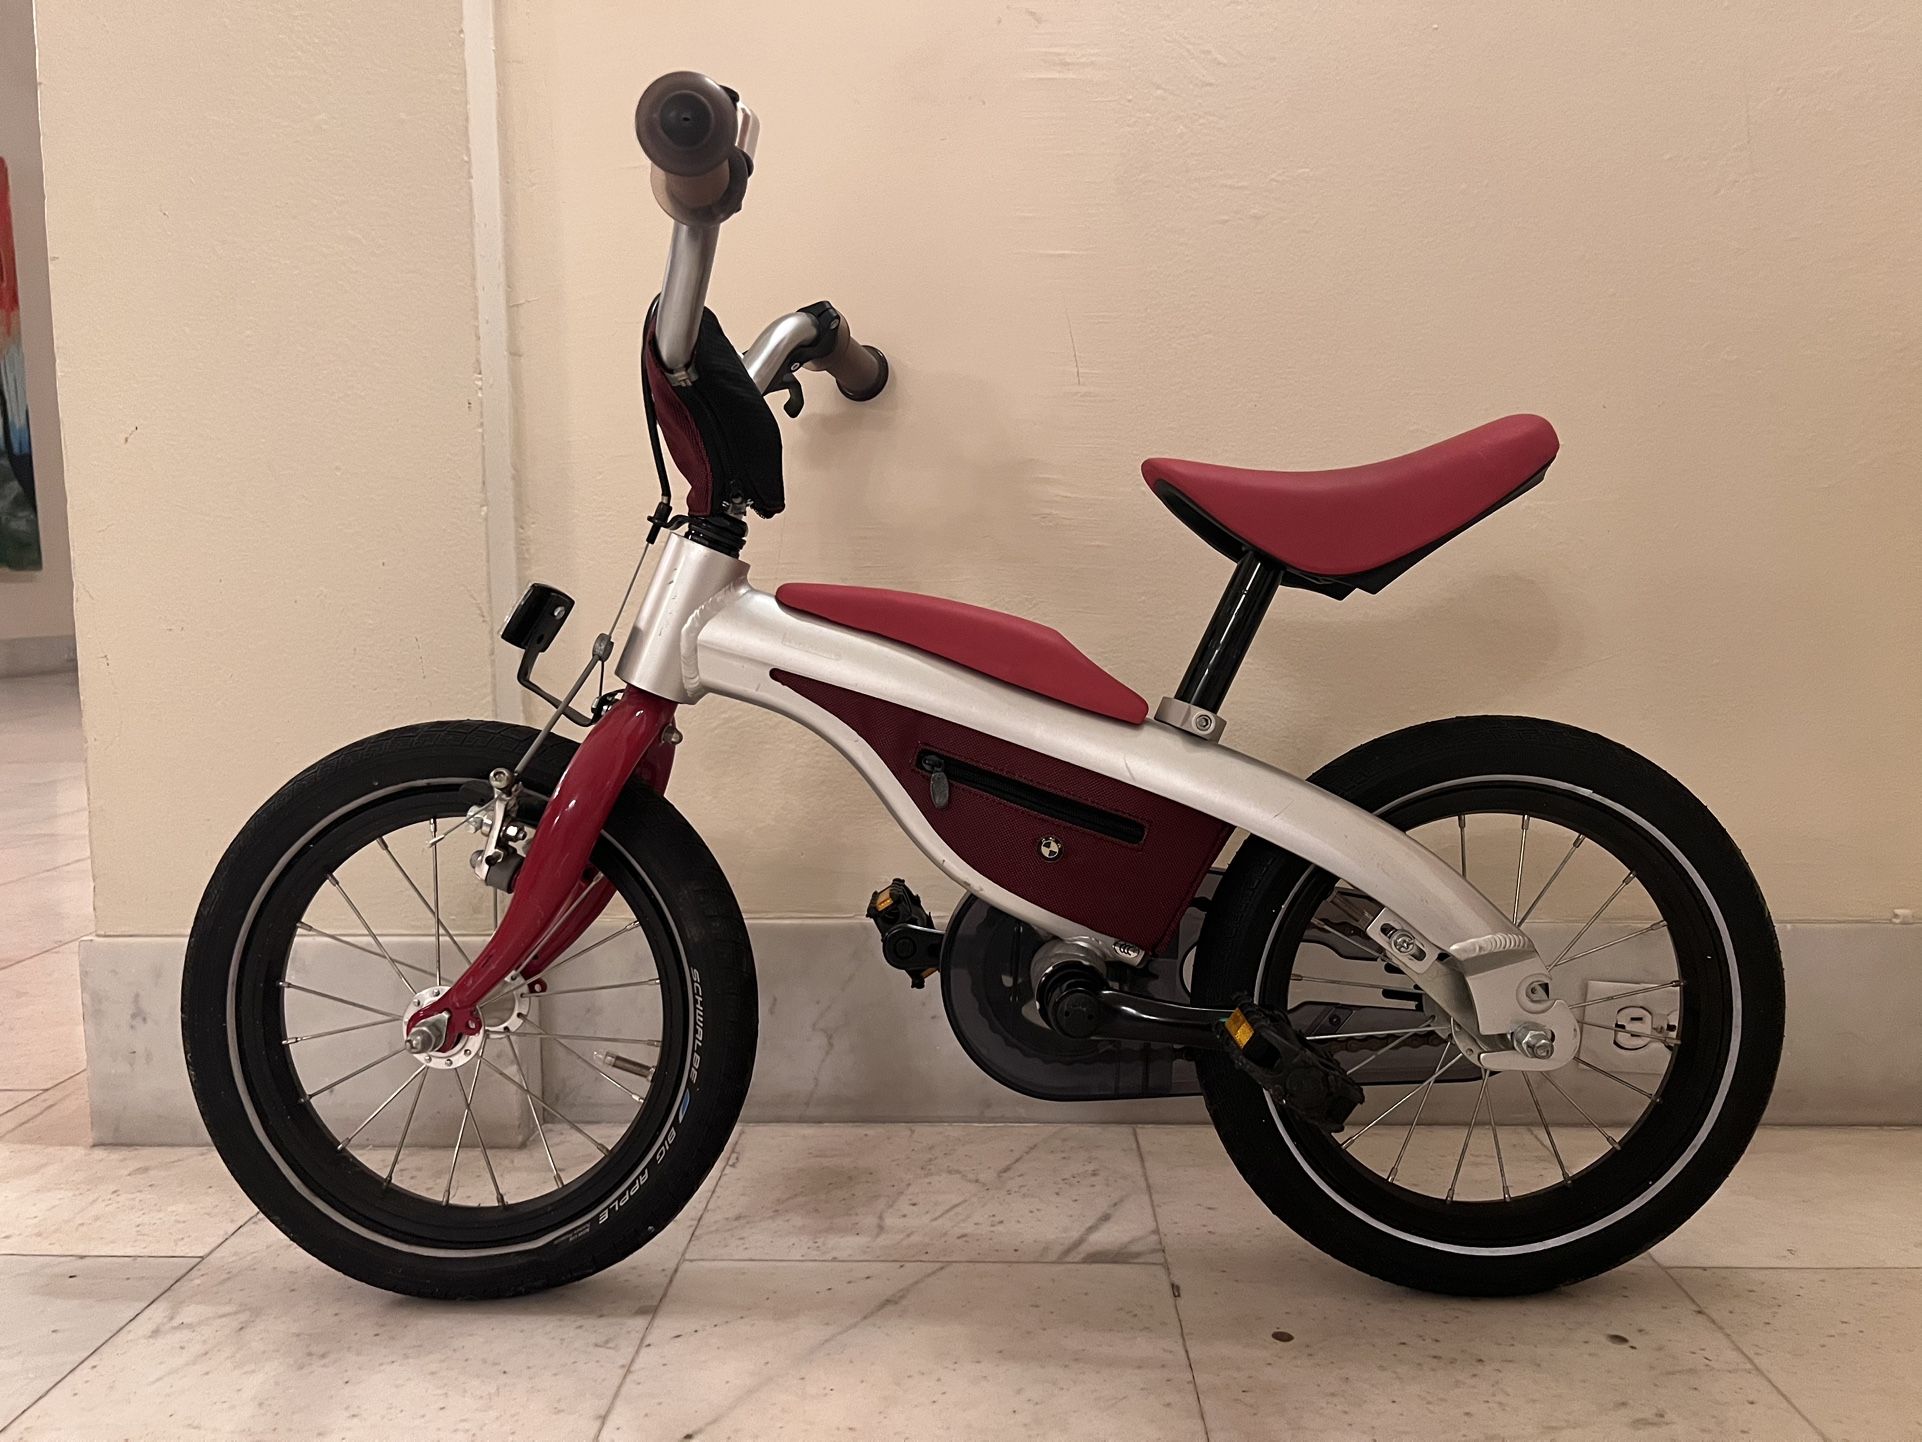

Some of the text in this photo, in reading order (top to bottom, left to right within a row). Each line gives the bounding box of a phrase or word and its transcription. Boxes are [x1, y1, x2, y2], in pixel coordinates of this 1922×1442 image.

[598, 967, 705, 1226] SCHWALBE BIG APPLE
